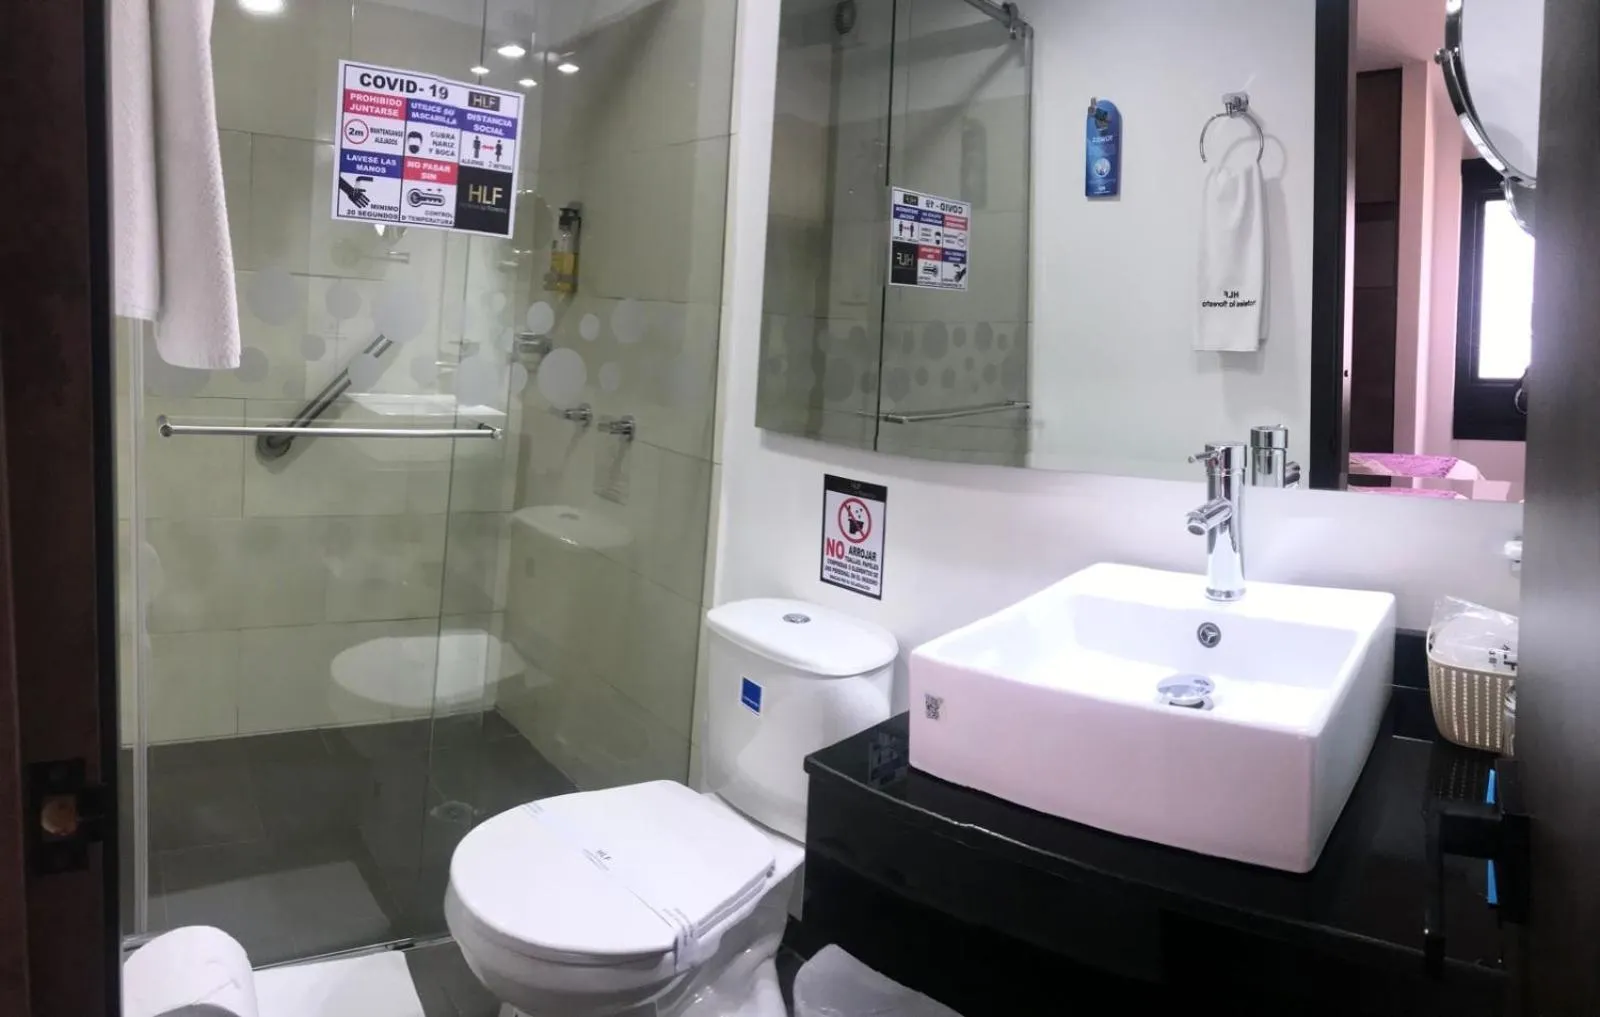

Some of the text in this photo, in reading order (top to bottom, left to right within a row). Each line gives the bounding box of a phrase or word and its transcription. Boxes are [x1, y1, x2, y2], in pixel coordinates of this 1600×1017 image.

[429, 84, 449, 100] 19
[350, 92, 402, 107] PROHIBIDO
[472, 93, 497, 108] HLF
[350, 104, 400, 117] JUNTARSE
[411, 102, 456, 116] UTILICE SU
[466, 112, 513, 128] DISTANCIA
[348, 127, 364, 137] 2m
[430, 131, 455, 140] CUBRA
[473, 123, 505, 136] SOCIAL
[432, 140, 455, 148] NARIZ
[435, 149, 455, 157] BOCA
[346, 154, 397, 167] LAVESE LAS
[406, 160, 451, 173] NO PASAR
[356, 164, 387, 174] MANOS
[421, 172, 437, 180] SIN
[468, 183, 503, 206] HLF
[371, 203, 399, 212] MINIMO
[358, 211, 398, 220] SEGUNDOS
[408, 215, 453, 225] TEMPERATURA
[425, 210, 453, 219] CONTROL
[826, 537, 845, 560] NO
[848, 546, 877, 561] ARROJAR
